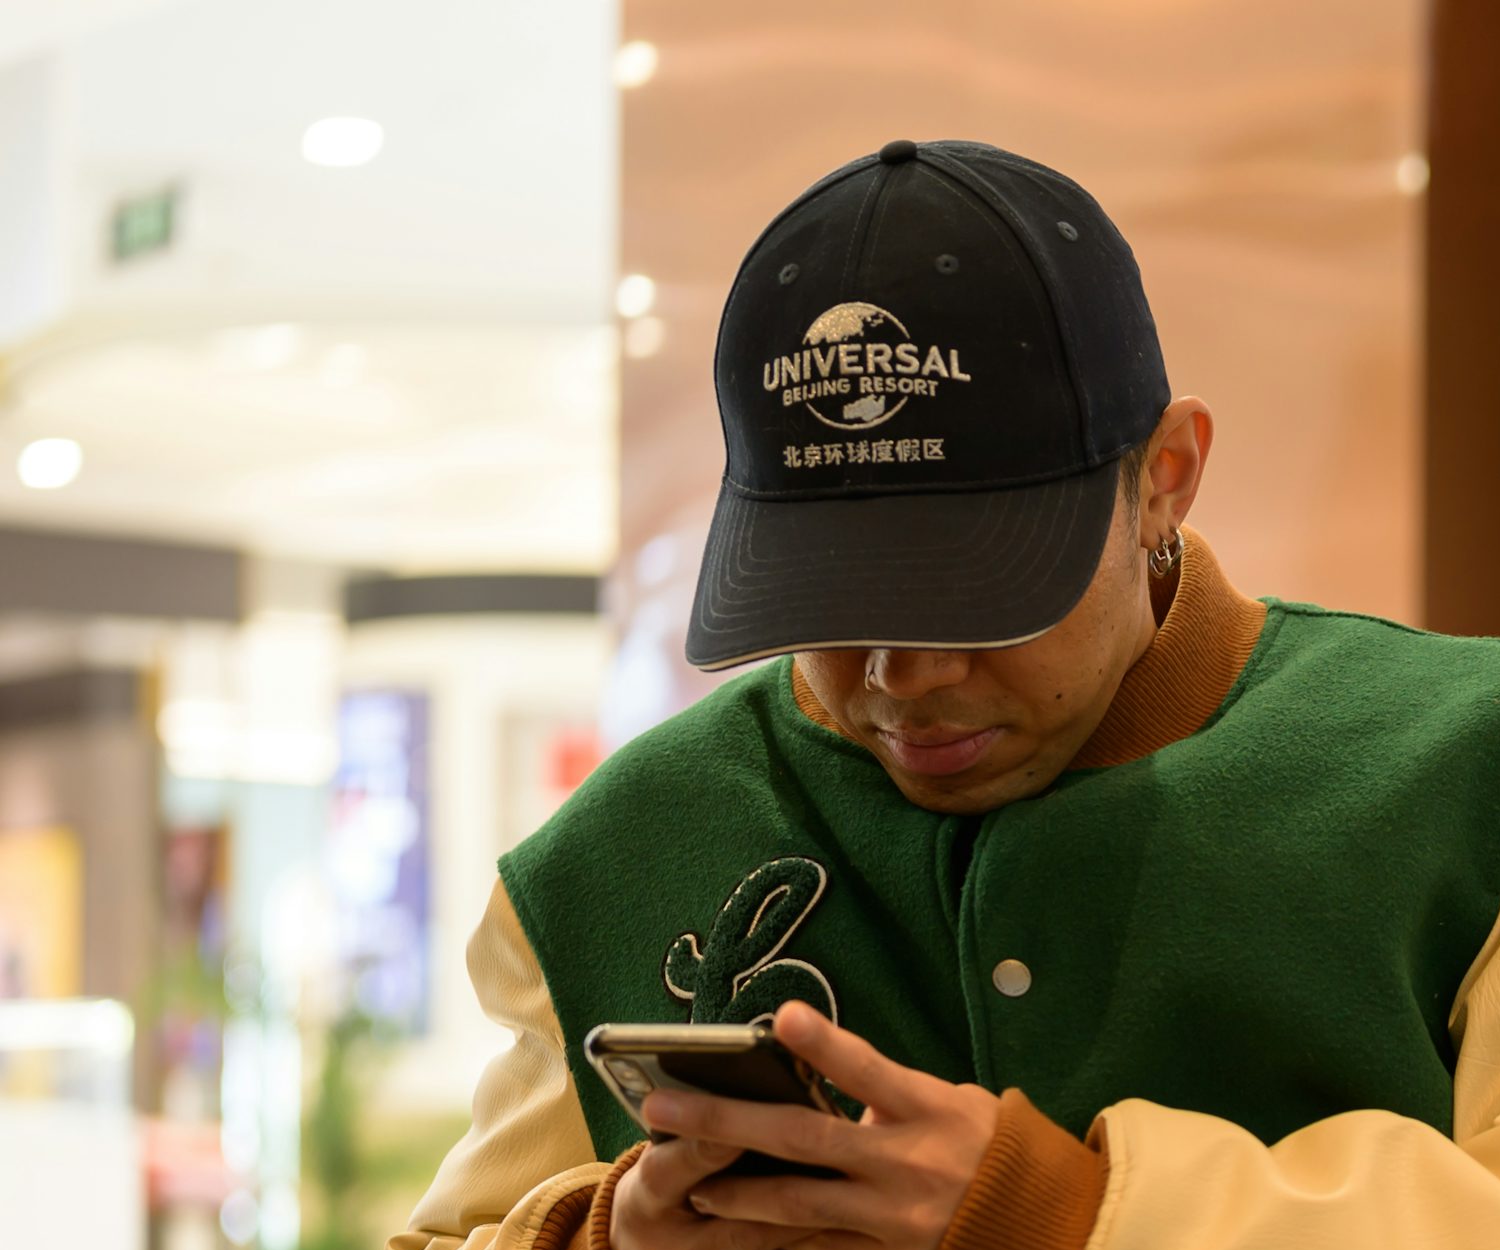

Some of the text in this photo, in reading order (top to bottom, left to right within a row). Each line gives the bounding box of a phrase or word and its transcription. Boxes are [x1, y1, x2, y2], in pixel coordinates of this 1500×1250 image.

[763, 343, 971, 391] UNIVERSAL
[782, 376, 938, 406] BEIJING RESORT
[783, 438, 945, 468] 北京环球度假区
